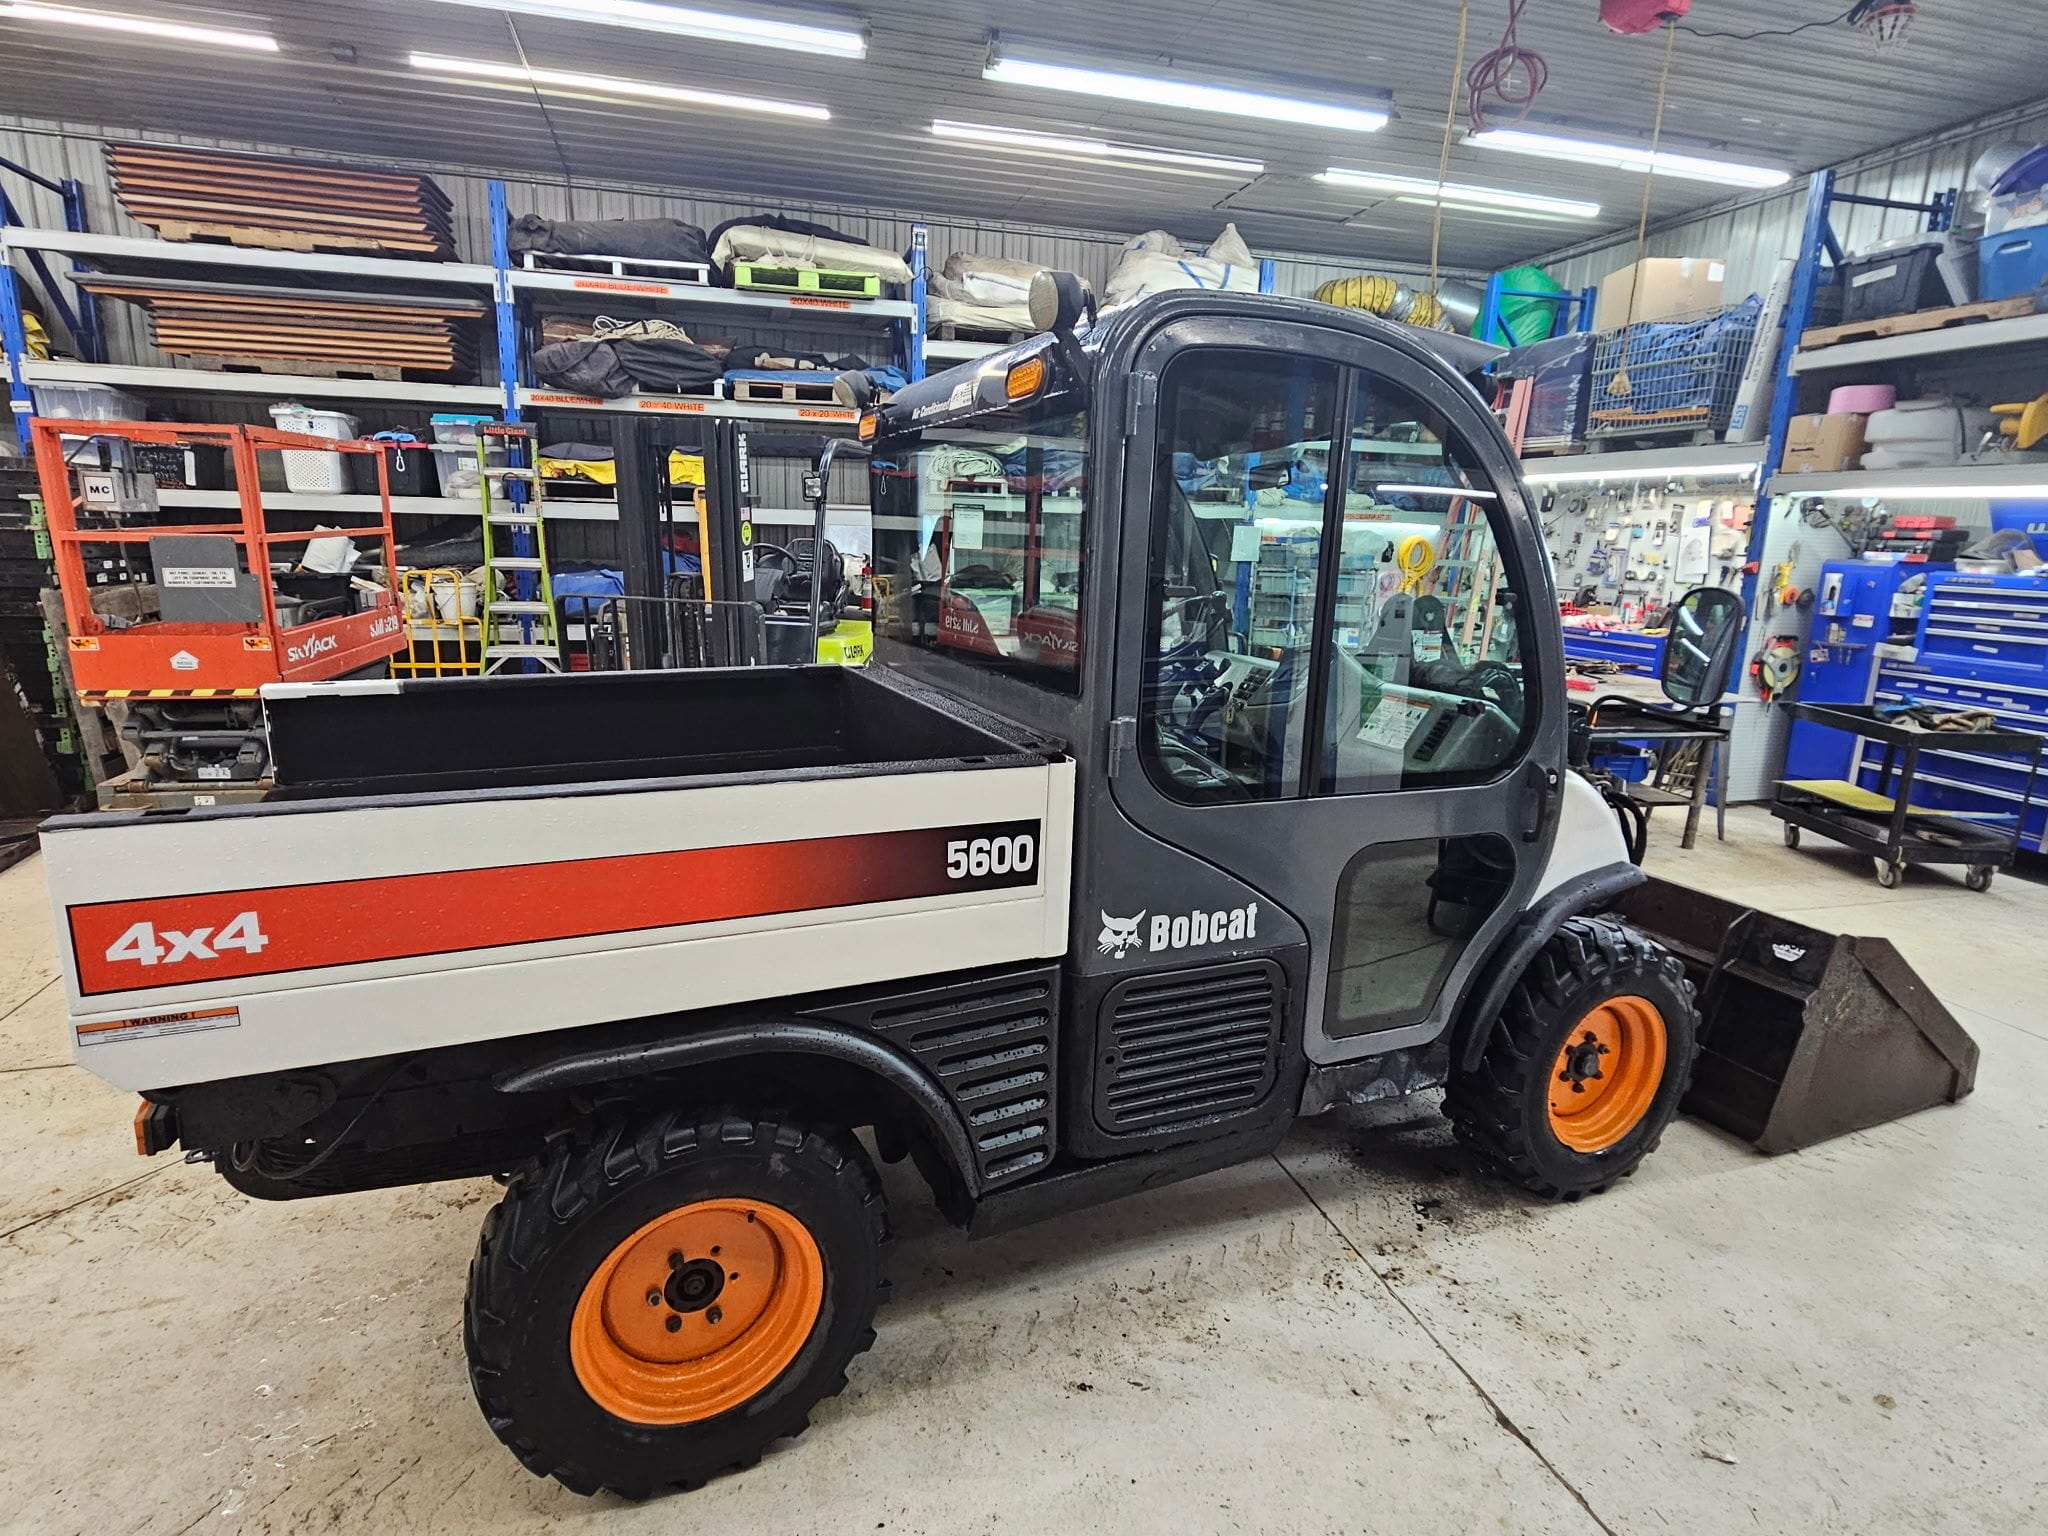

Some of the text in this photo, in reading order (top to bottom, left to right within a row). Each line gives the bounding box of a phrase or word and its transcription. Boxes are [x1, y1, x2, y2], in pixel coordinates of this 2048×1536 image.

[640, 401, 652, 409] 20
[661, 402, 672, 410] 40
[673, 402, 704, 412] WHITE
[738, 432, 749, 493] CLARK
[287, 633, 338, 662] SKYJACK
[946, 834, 1034, 879] 5600
[105, 911, 269, 966] 4x4
[1149, 902, 1258, 952] Bobcat
[129, 1013, 188, 1027] WARNING
